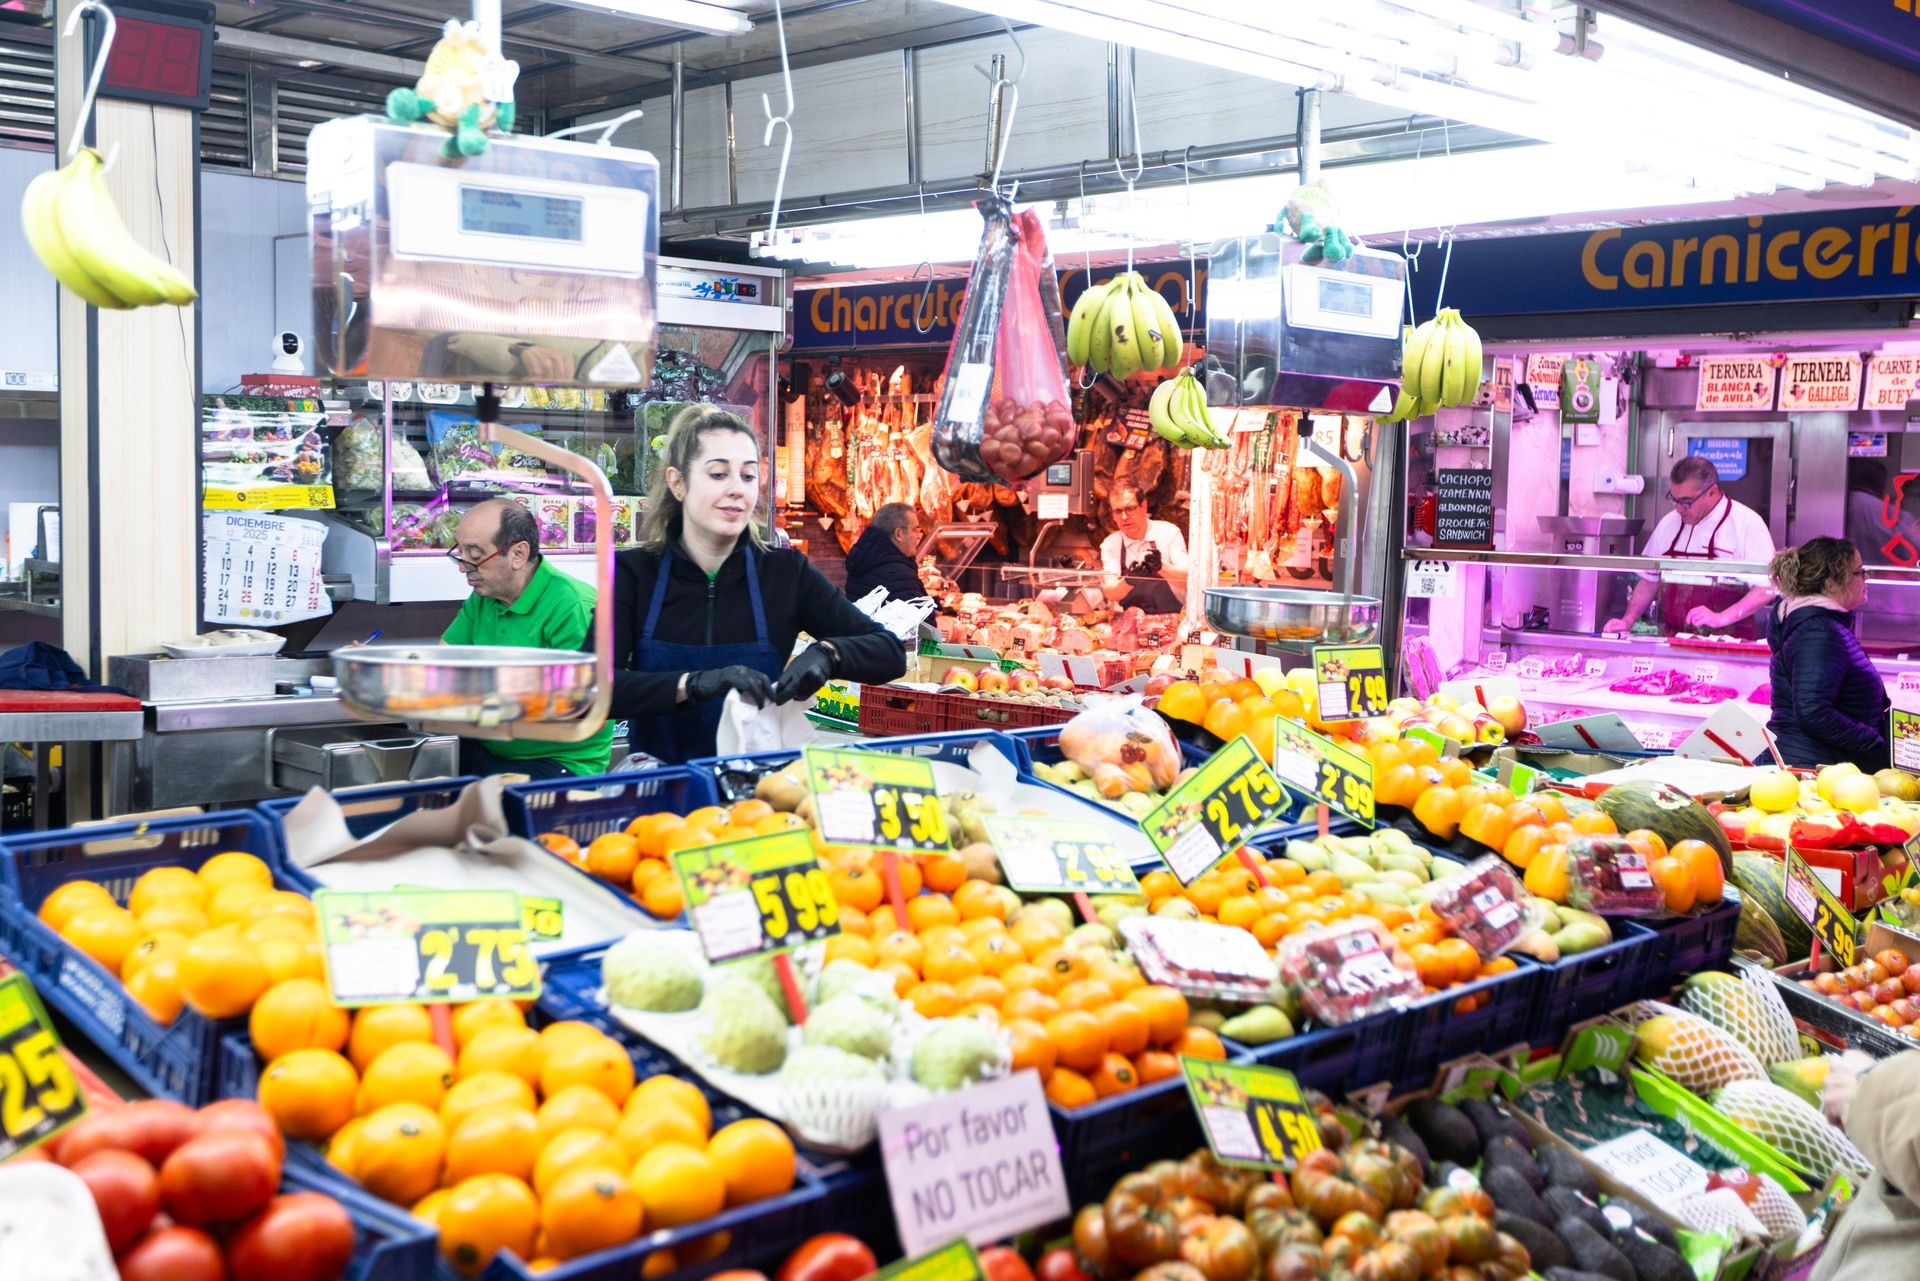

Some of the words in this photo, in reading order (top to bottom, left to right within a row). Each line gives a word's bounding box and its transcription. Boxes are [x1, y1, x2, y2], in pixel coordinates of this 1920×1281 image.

[1581, 205, 1920, 291] Carnicerí
[1709, 363, 1763, 380] TERNERA
[1792, 362, 1851, 382] TERNERA
[1878, 360, 1913, 375] CARNE
[1707, 382, 1751, 393] BLANCA
[1892, 377, 1906, 386] de
[1706, 393, 1719, 403] de
[1808, 386, 1849, 402] GALLEGA
[1878, 389, 1914, 404] BUEY
[1439, 474, 1492, 487] CACHOPO
[226, 516, 285, 531] DICIEMBRE
[243, 528, 268, 540] 2025
[1439, 529, 1486, 541] SANDWICH
[225, 543, 231, 554] 3
[248, 545, 253, 557] 4
[270, 547, 276, 559] 5
[292, 550, 298, 561] 6
[315, 552, 319, 564] 7
[222, 558, 232, 570] 10
[245, 560, 254, 573] 11
[267, 562, 277, 575] 12
[289, 564, 299, 577] 13
[220, 573, 230, 586] 17
[243, 576, 252, 588] 18
[266, 578, 275, 590] 19
[287, 580, 297, 592] 20
[310, 582, 319, 595] 21
[218, 589, 229, 601] 24
[241, 591, 252, 603] 25
[264, 593, 274, 605] 26
[285, 595, 296, 607] 27
[308, 597, 318, 610] 28
[218, 604, 227, 616] 31
[817, 696, 860, 720] OMAS
[903, 1120, 951, 1164] Por
[960, 1101, 1028, 1147] favor
[1610, 1140, 1660, 1167] favor
[1640, 1161, 1701, 1197] TOCAR
[912, 1178, 956, 1228] NO
[960, 1150, 1051, 1210] TOCAR
